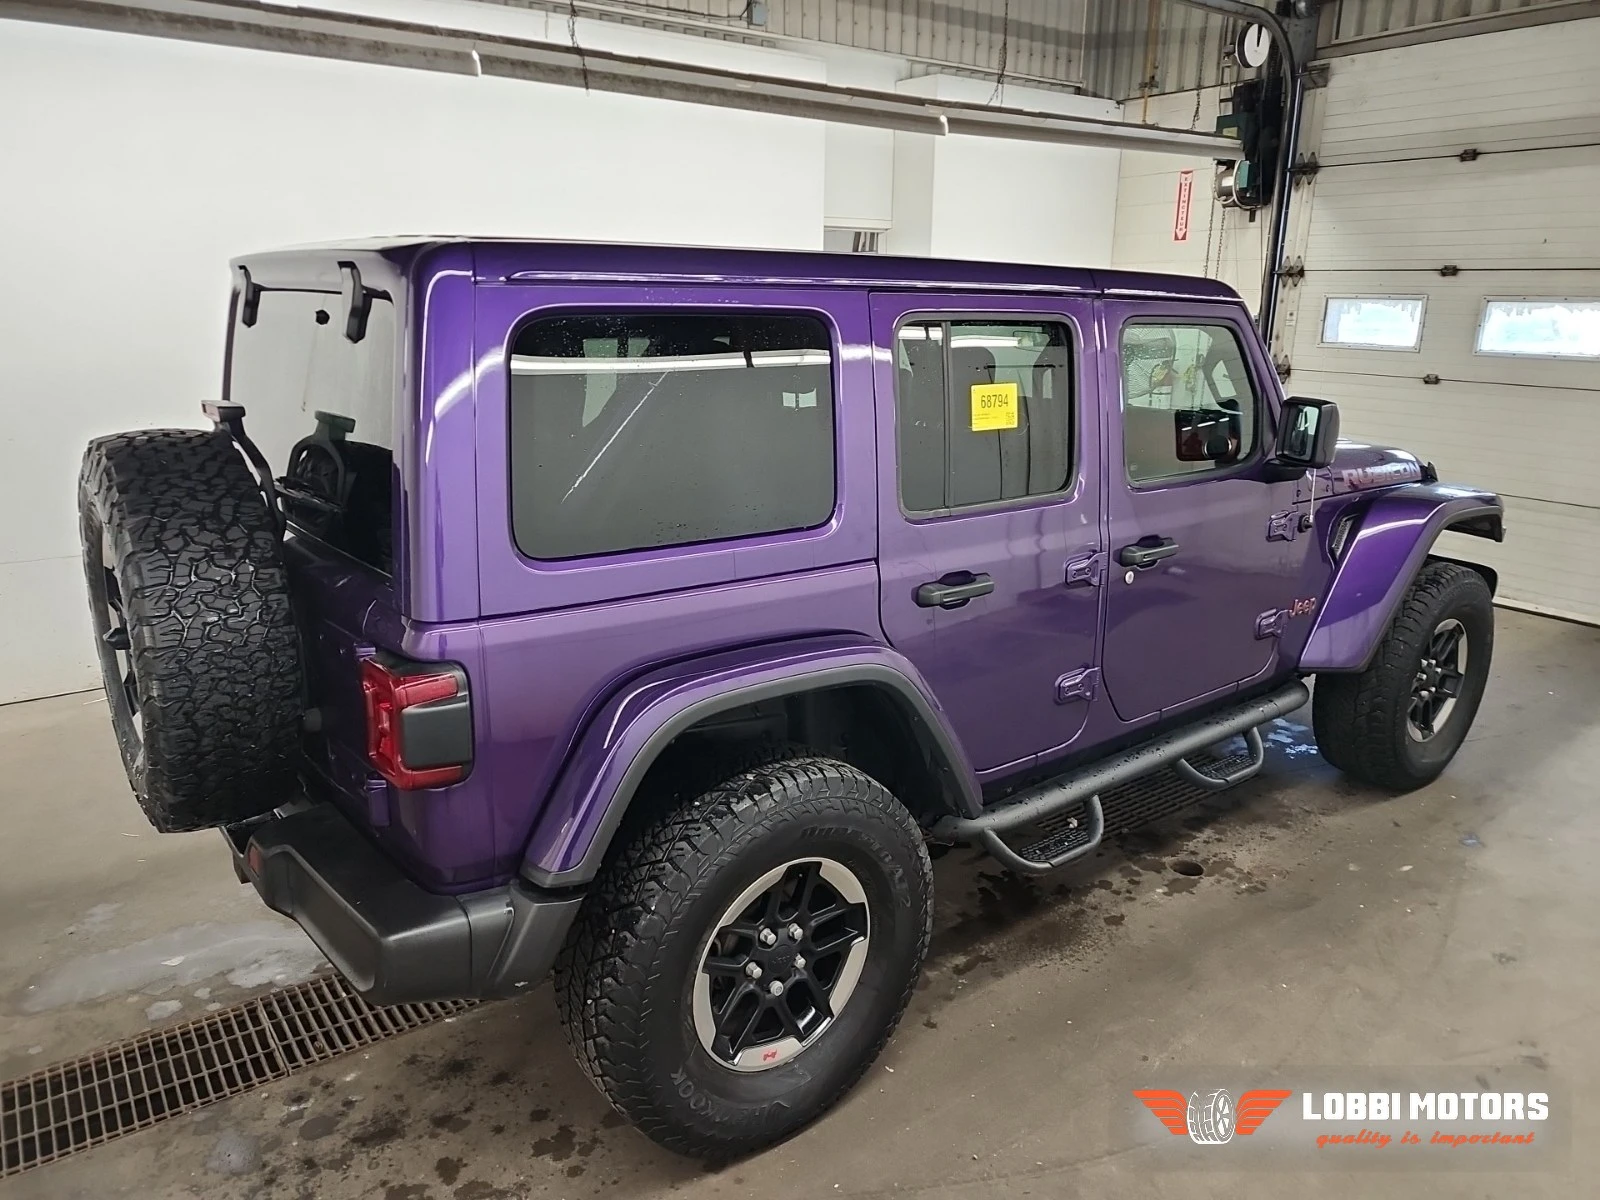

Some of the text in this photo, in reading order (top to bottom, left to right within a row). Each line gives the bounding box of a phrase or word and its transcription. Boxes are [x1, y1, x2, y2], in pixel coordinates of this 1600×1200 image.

[1178, 176, 1189, 232] EXTINCTEUR
[980, 393, 1009, 409] 68794
[1341, 460, 1422, 487] RUBICON
[1289, 597, 1317, 618] Jeep
